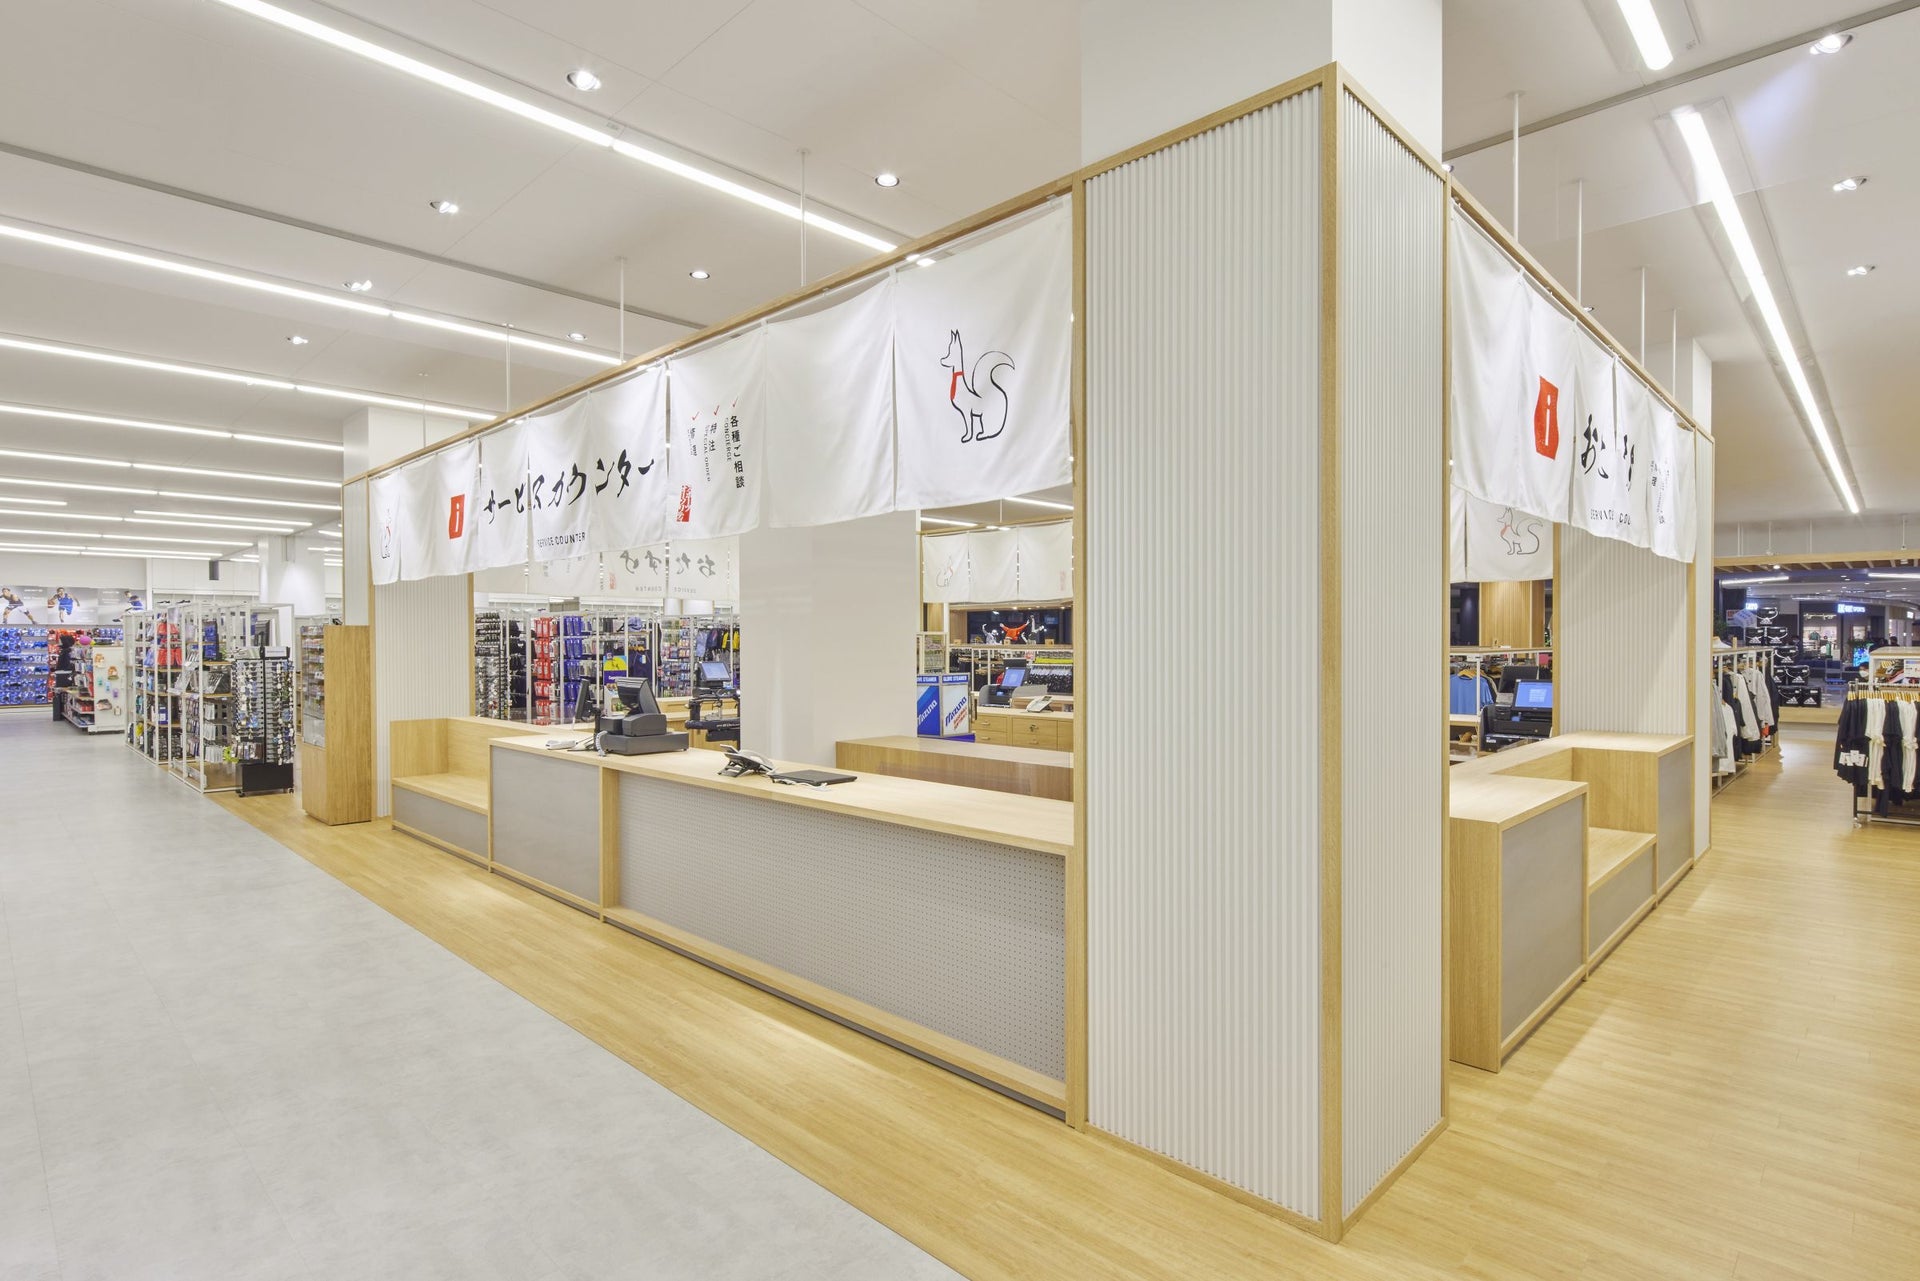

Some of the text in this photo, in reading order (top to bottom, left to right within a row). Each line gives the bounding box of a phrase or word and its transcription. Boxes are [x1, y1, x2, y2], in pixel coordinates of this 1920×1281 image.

[730, 415, 746, 489] 各種ご相談
[554, 531, 586, 545] COUNTER
